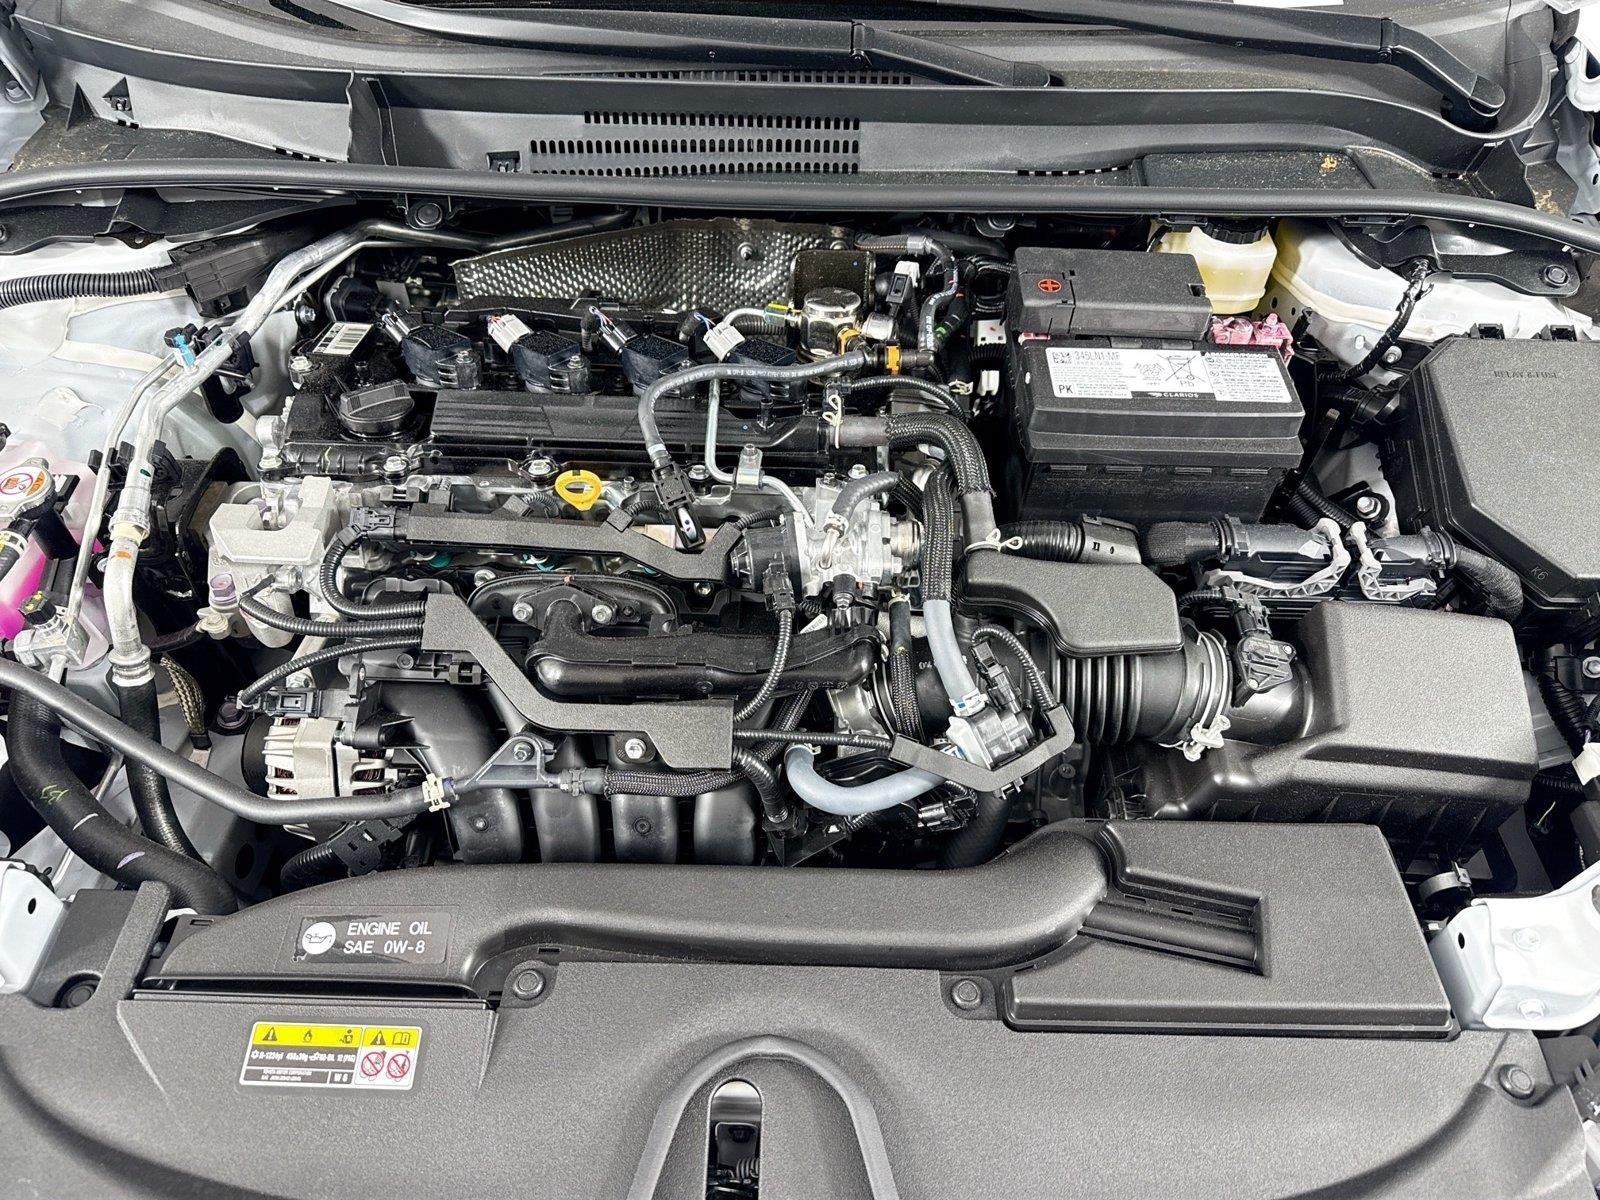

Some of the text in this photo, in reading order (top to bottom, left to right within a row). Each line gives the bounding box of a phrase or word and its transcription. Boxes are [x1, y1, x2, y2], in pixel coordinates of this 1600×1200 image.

[1493, 370, 1524, 378] RELAY
[1535, 371, 1558, 379] FUSE
[1058, 384, 1074, 394] PK
[347, 921, 432, 936] ENGINE OIL
[343, 940, 426, 954] SAE 0W-8
